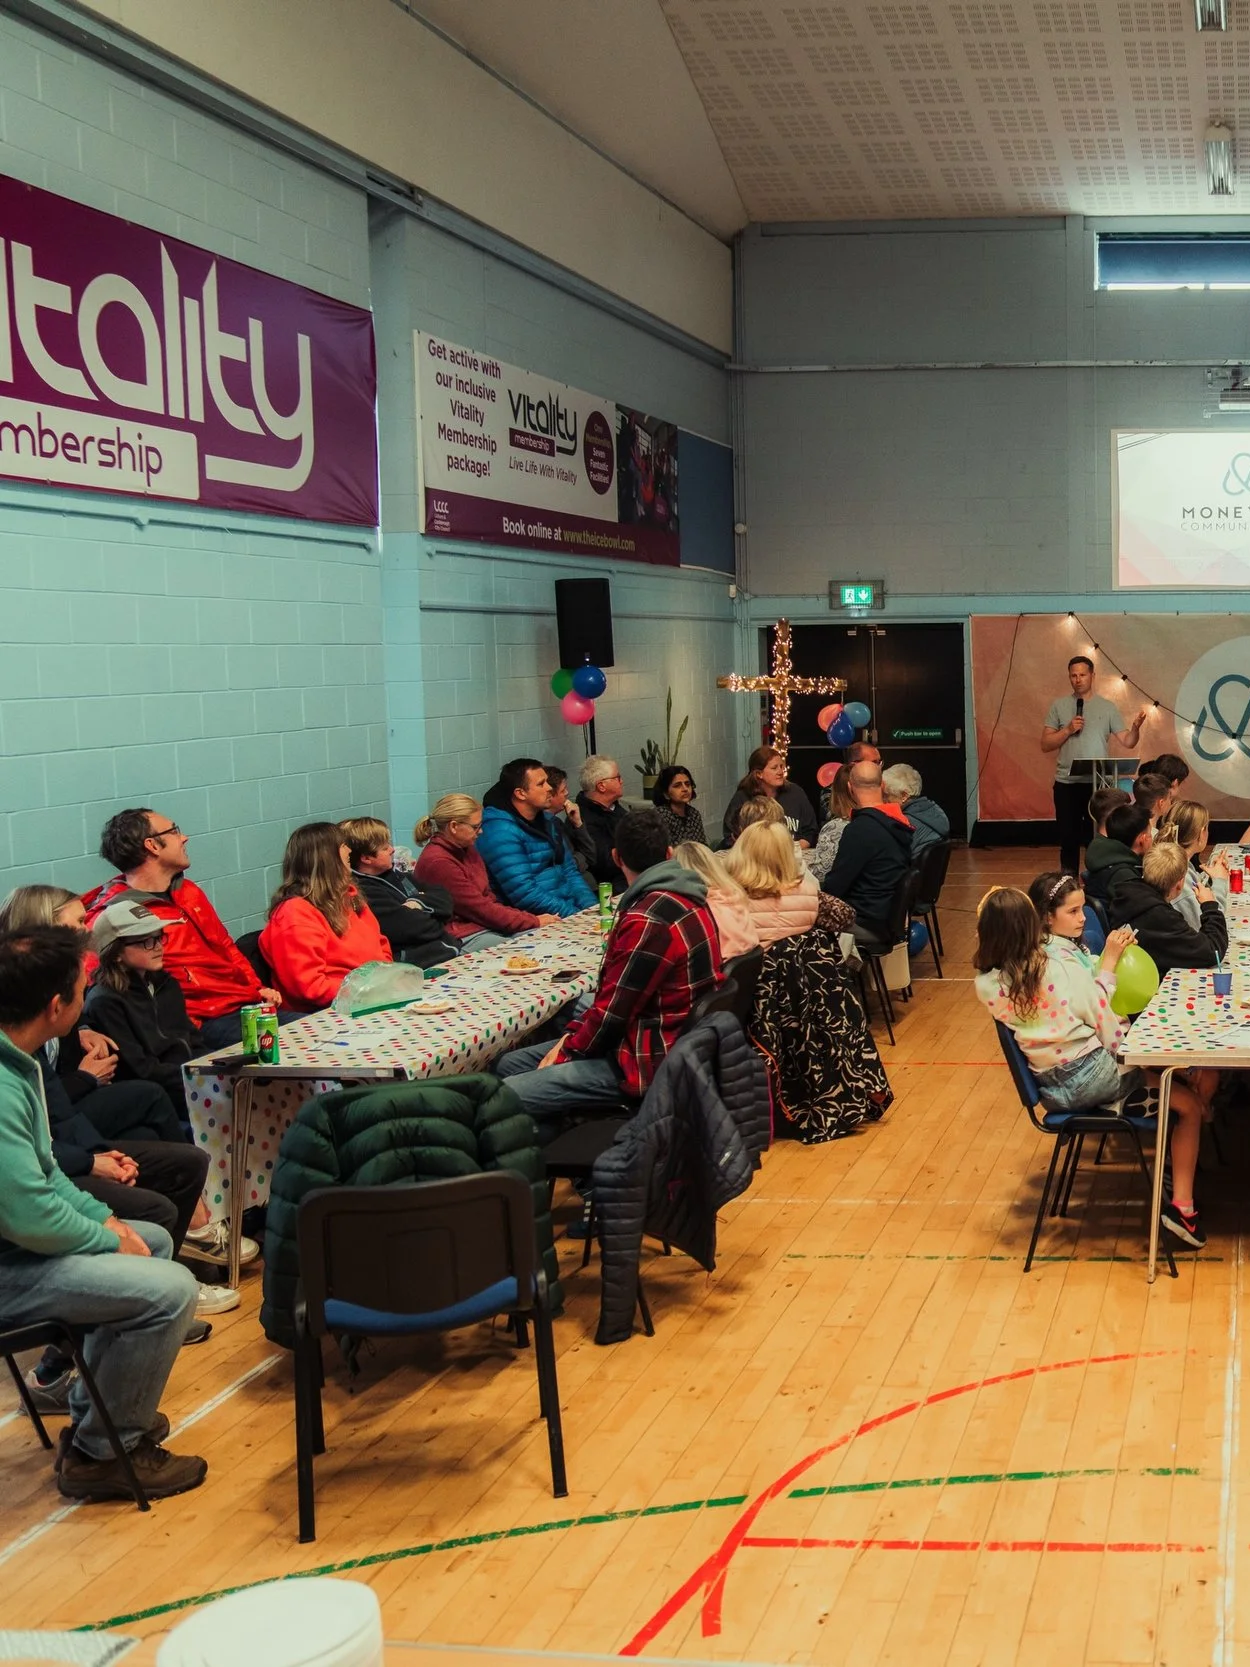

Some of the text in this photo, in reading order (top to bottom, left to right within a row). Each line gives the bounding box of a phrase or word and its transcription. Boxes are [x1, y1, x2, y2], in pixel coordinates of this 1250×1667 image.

[428, 338, 502, 379] Get active with
[436, 371, 496, 402] our inclusive
[450, 399, 485, 427] Vitality
[437, 421, 497, 455] Membership
[514, 433, 550, 454] membership
[446, 454, 491, 478] package!
[509, 456, 578, 486] Live Life With Vitality
[502, 516, 636, 552] Book online at www.theicebowl.com
